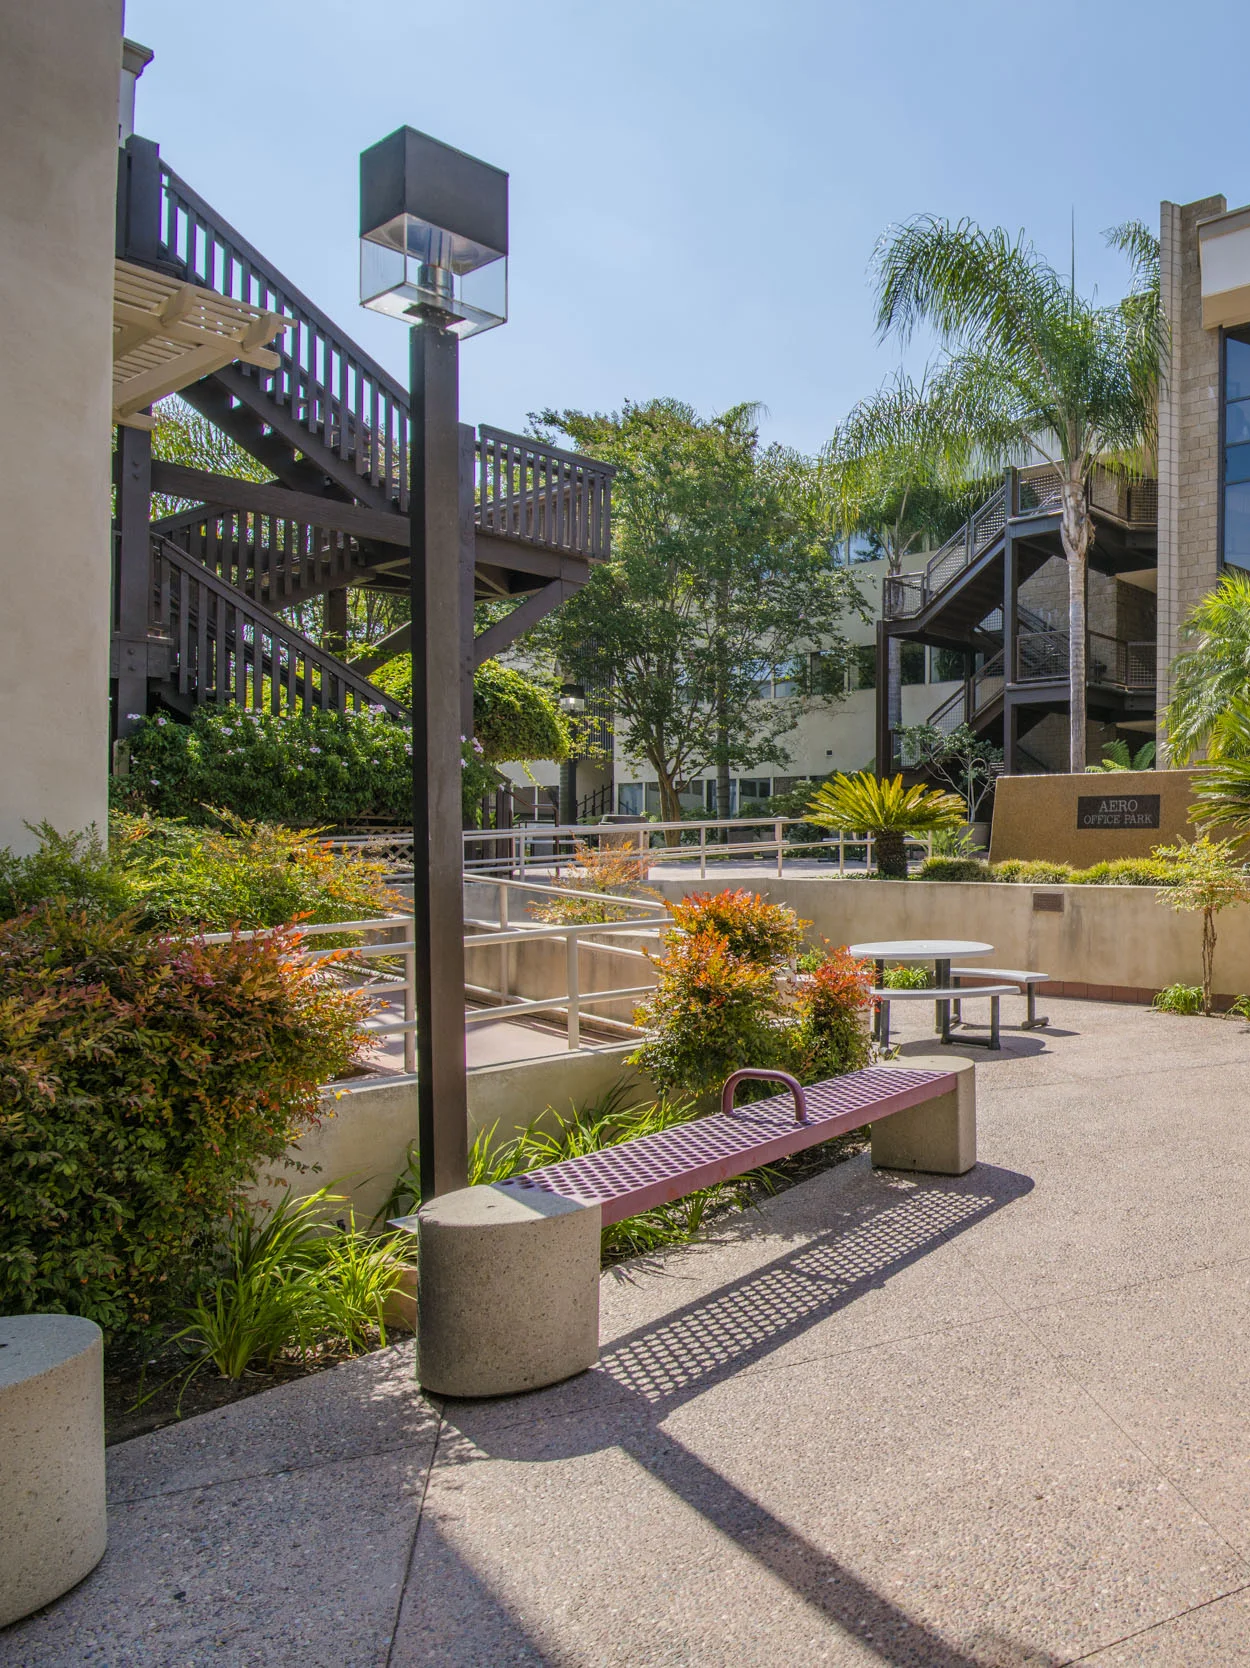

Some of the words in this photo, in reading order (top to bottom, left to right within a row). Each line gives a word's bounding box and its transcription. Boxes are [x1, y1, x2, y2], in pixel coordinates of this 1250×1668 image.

[1099, 799, 1138, 812] AERO
[1083, 815, 1120, 825] OFFICE
[1124, 814, 1152, 825] PARK
